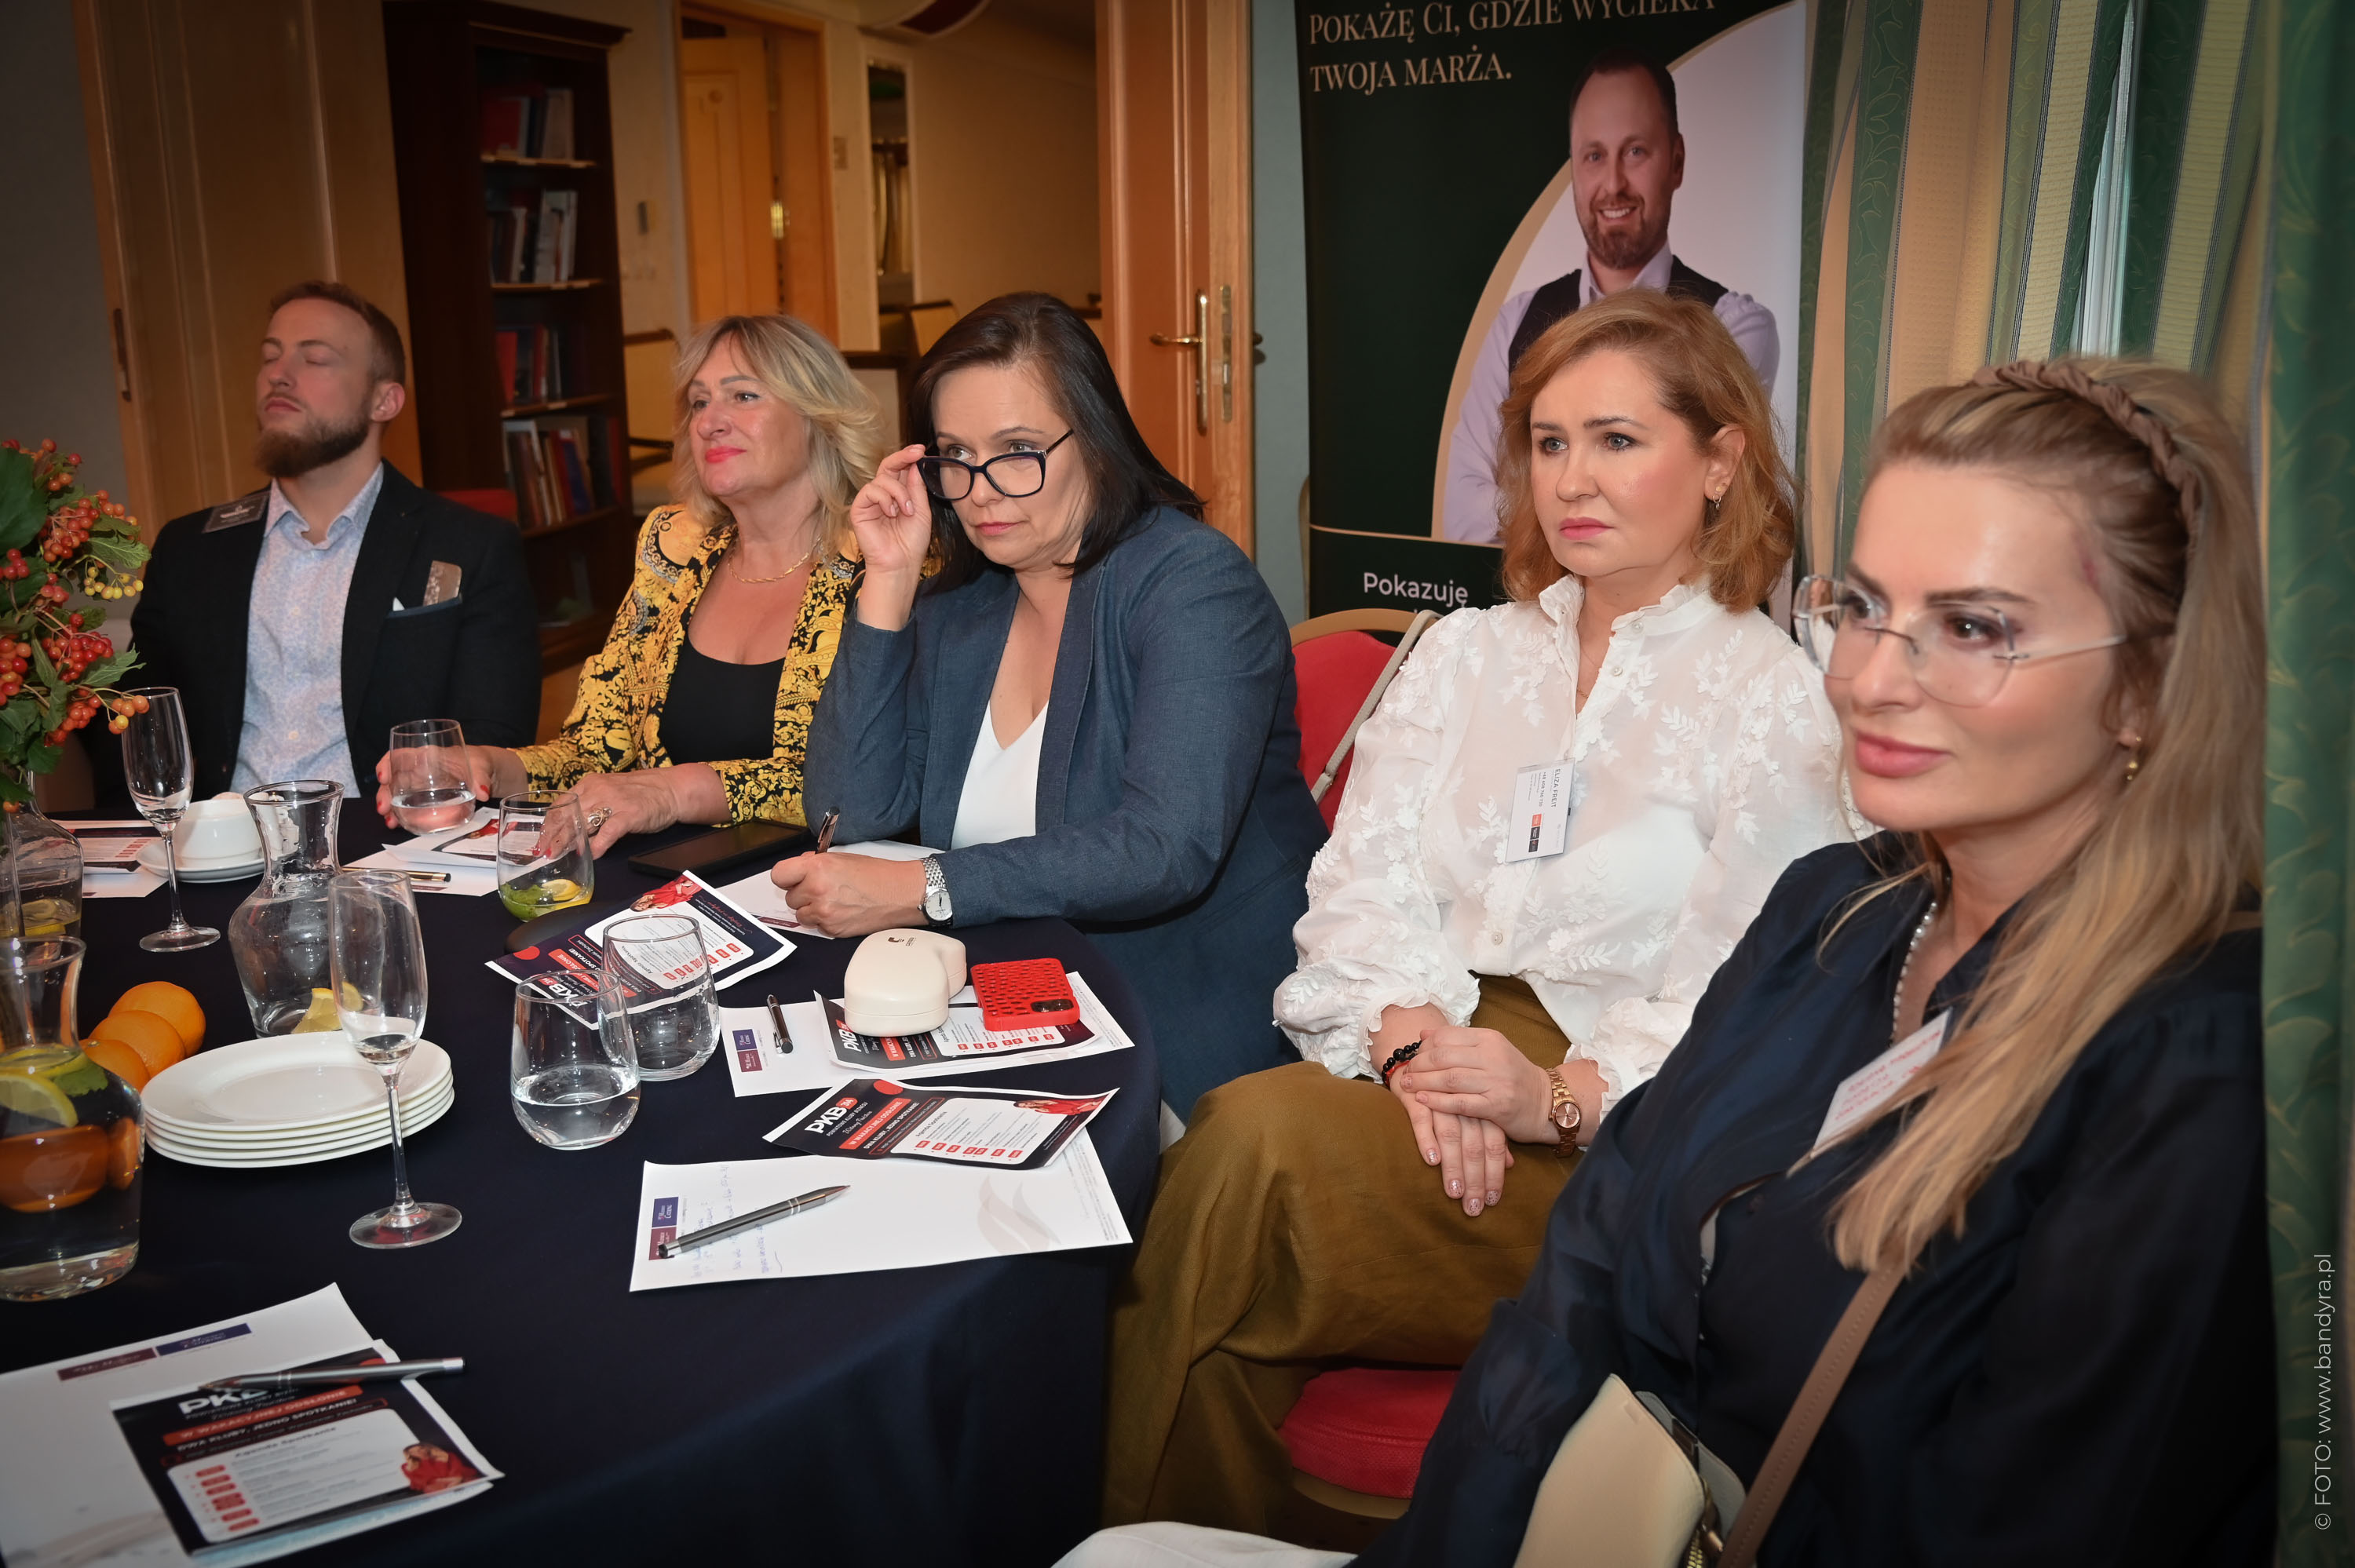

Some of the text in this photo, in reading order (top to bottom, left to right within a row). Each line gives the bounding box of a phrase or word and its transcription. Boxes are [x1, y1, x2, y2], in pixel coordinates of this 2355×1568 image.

[1309, 2, 1414, 44] POKAŻĘ
[1423, 2, 1460, 37] CI,
[1469, 0, 1562, 30] GDZIE
[1309, 45, 1512, 96] TWOJA MARŻA.
[1364, 572, 1469, 607] Pokazuję
[838, 1029, 862, 1052] PKB
[805, 1106, 848, 1134] PKB
